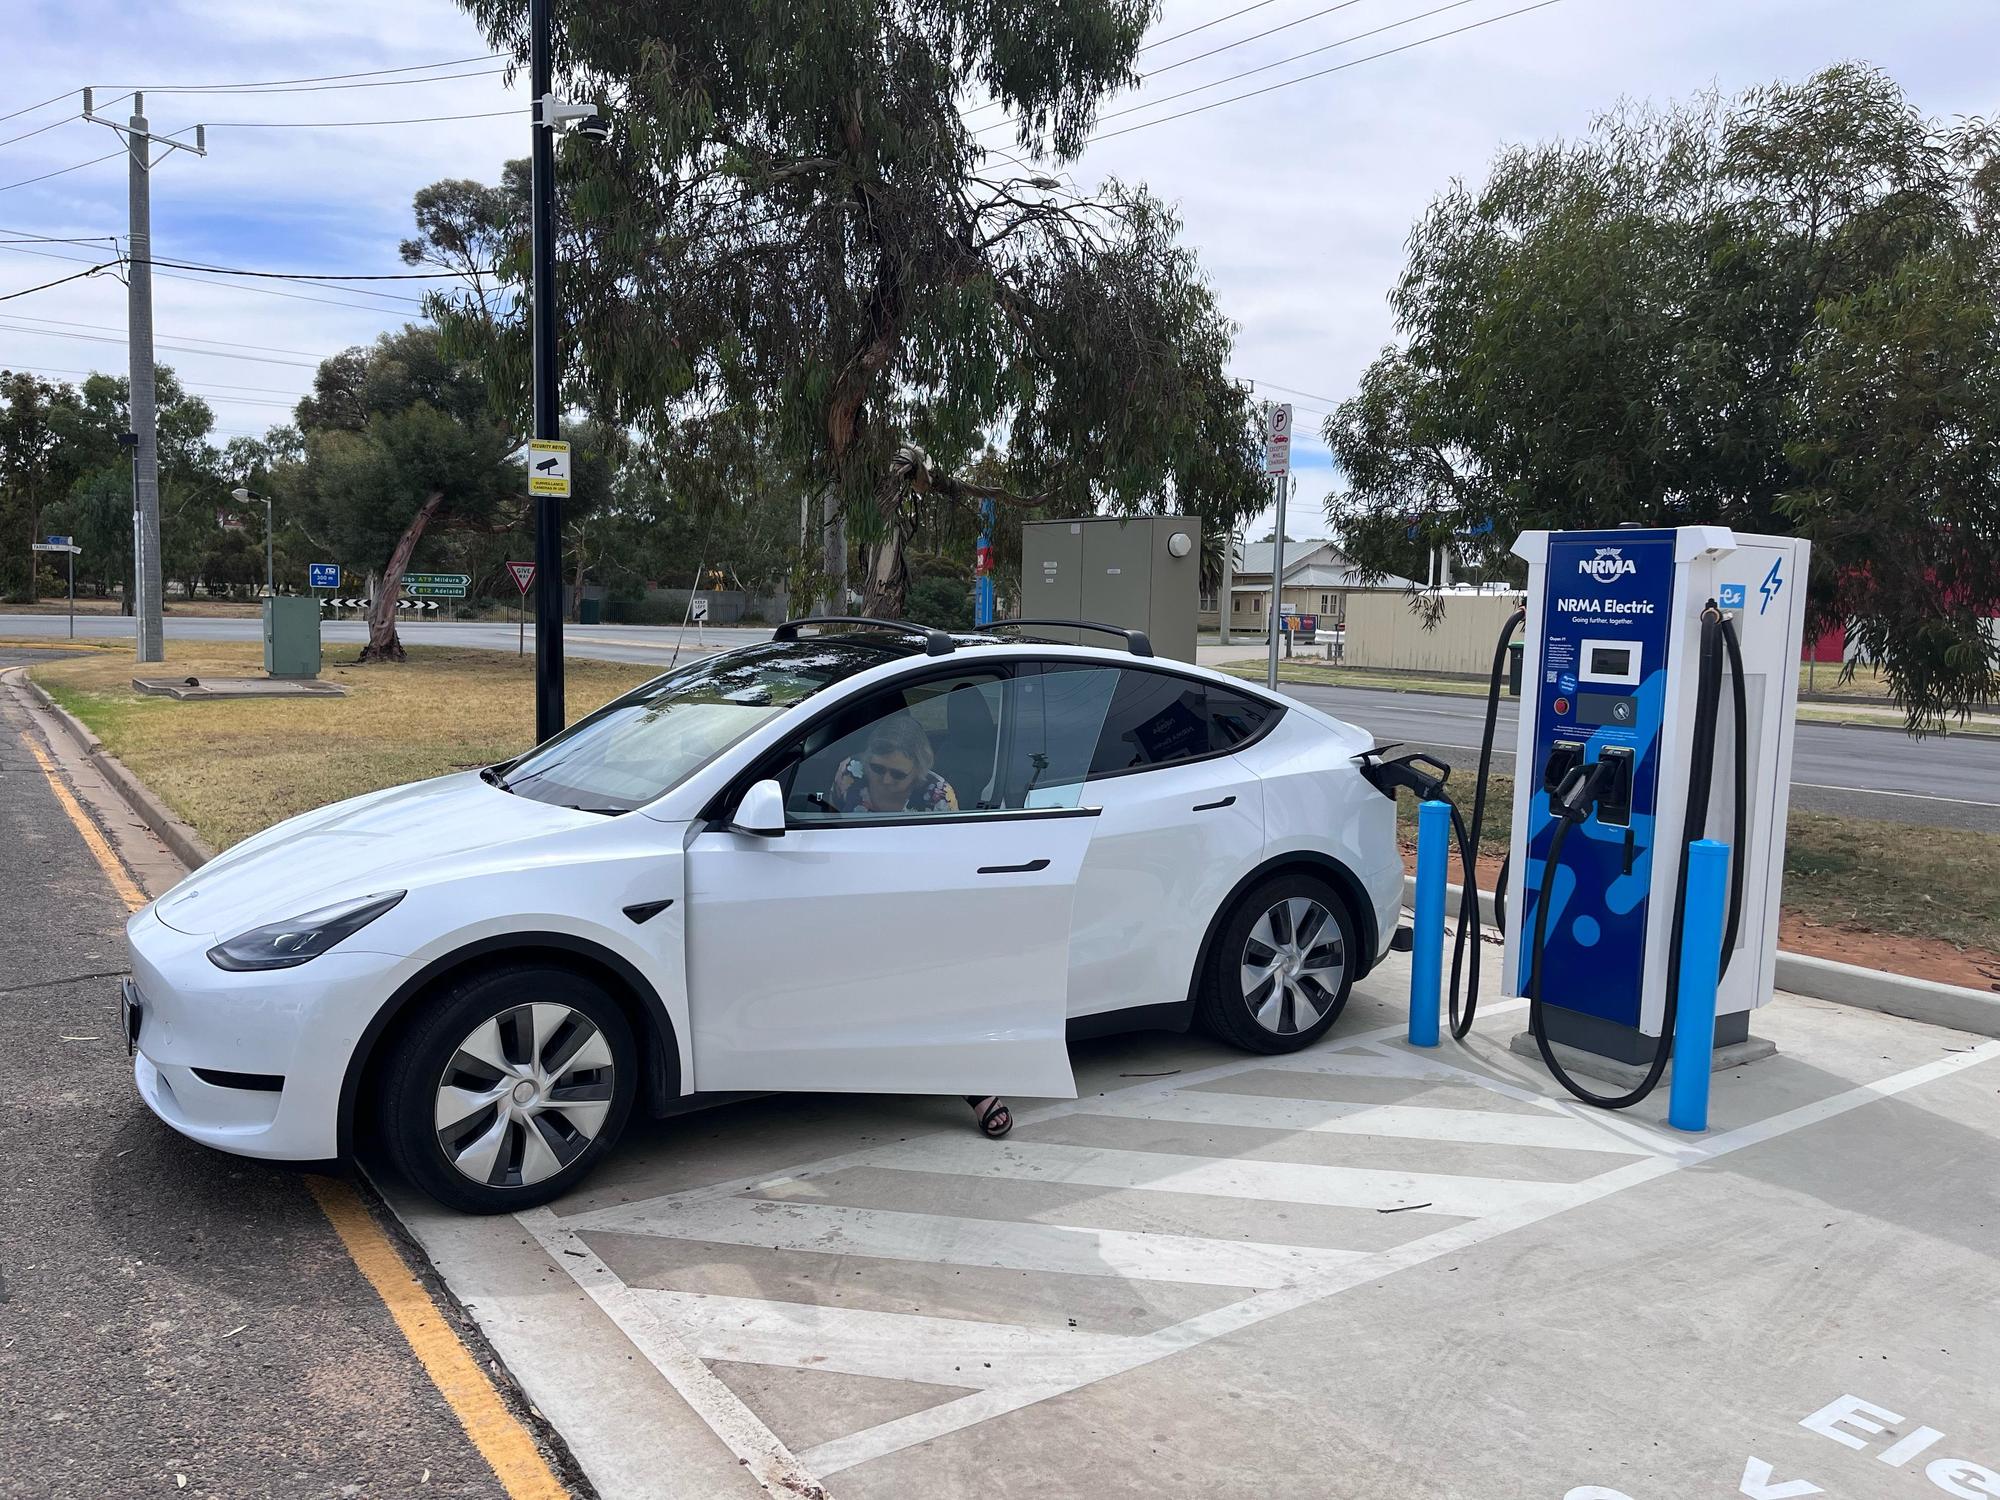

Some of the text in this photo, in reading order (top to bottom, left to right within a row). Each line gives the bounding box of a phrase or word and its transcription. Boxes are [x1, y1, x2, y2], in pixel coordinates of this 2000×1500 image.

[1578, 559, 1637, 574] NRMA
[1557, 598, 1654, 614] NRMA Electric
[1572, 616, 1588, 624] Going
